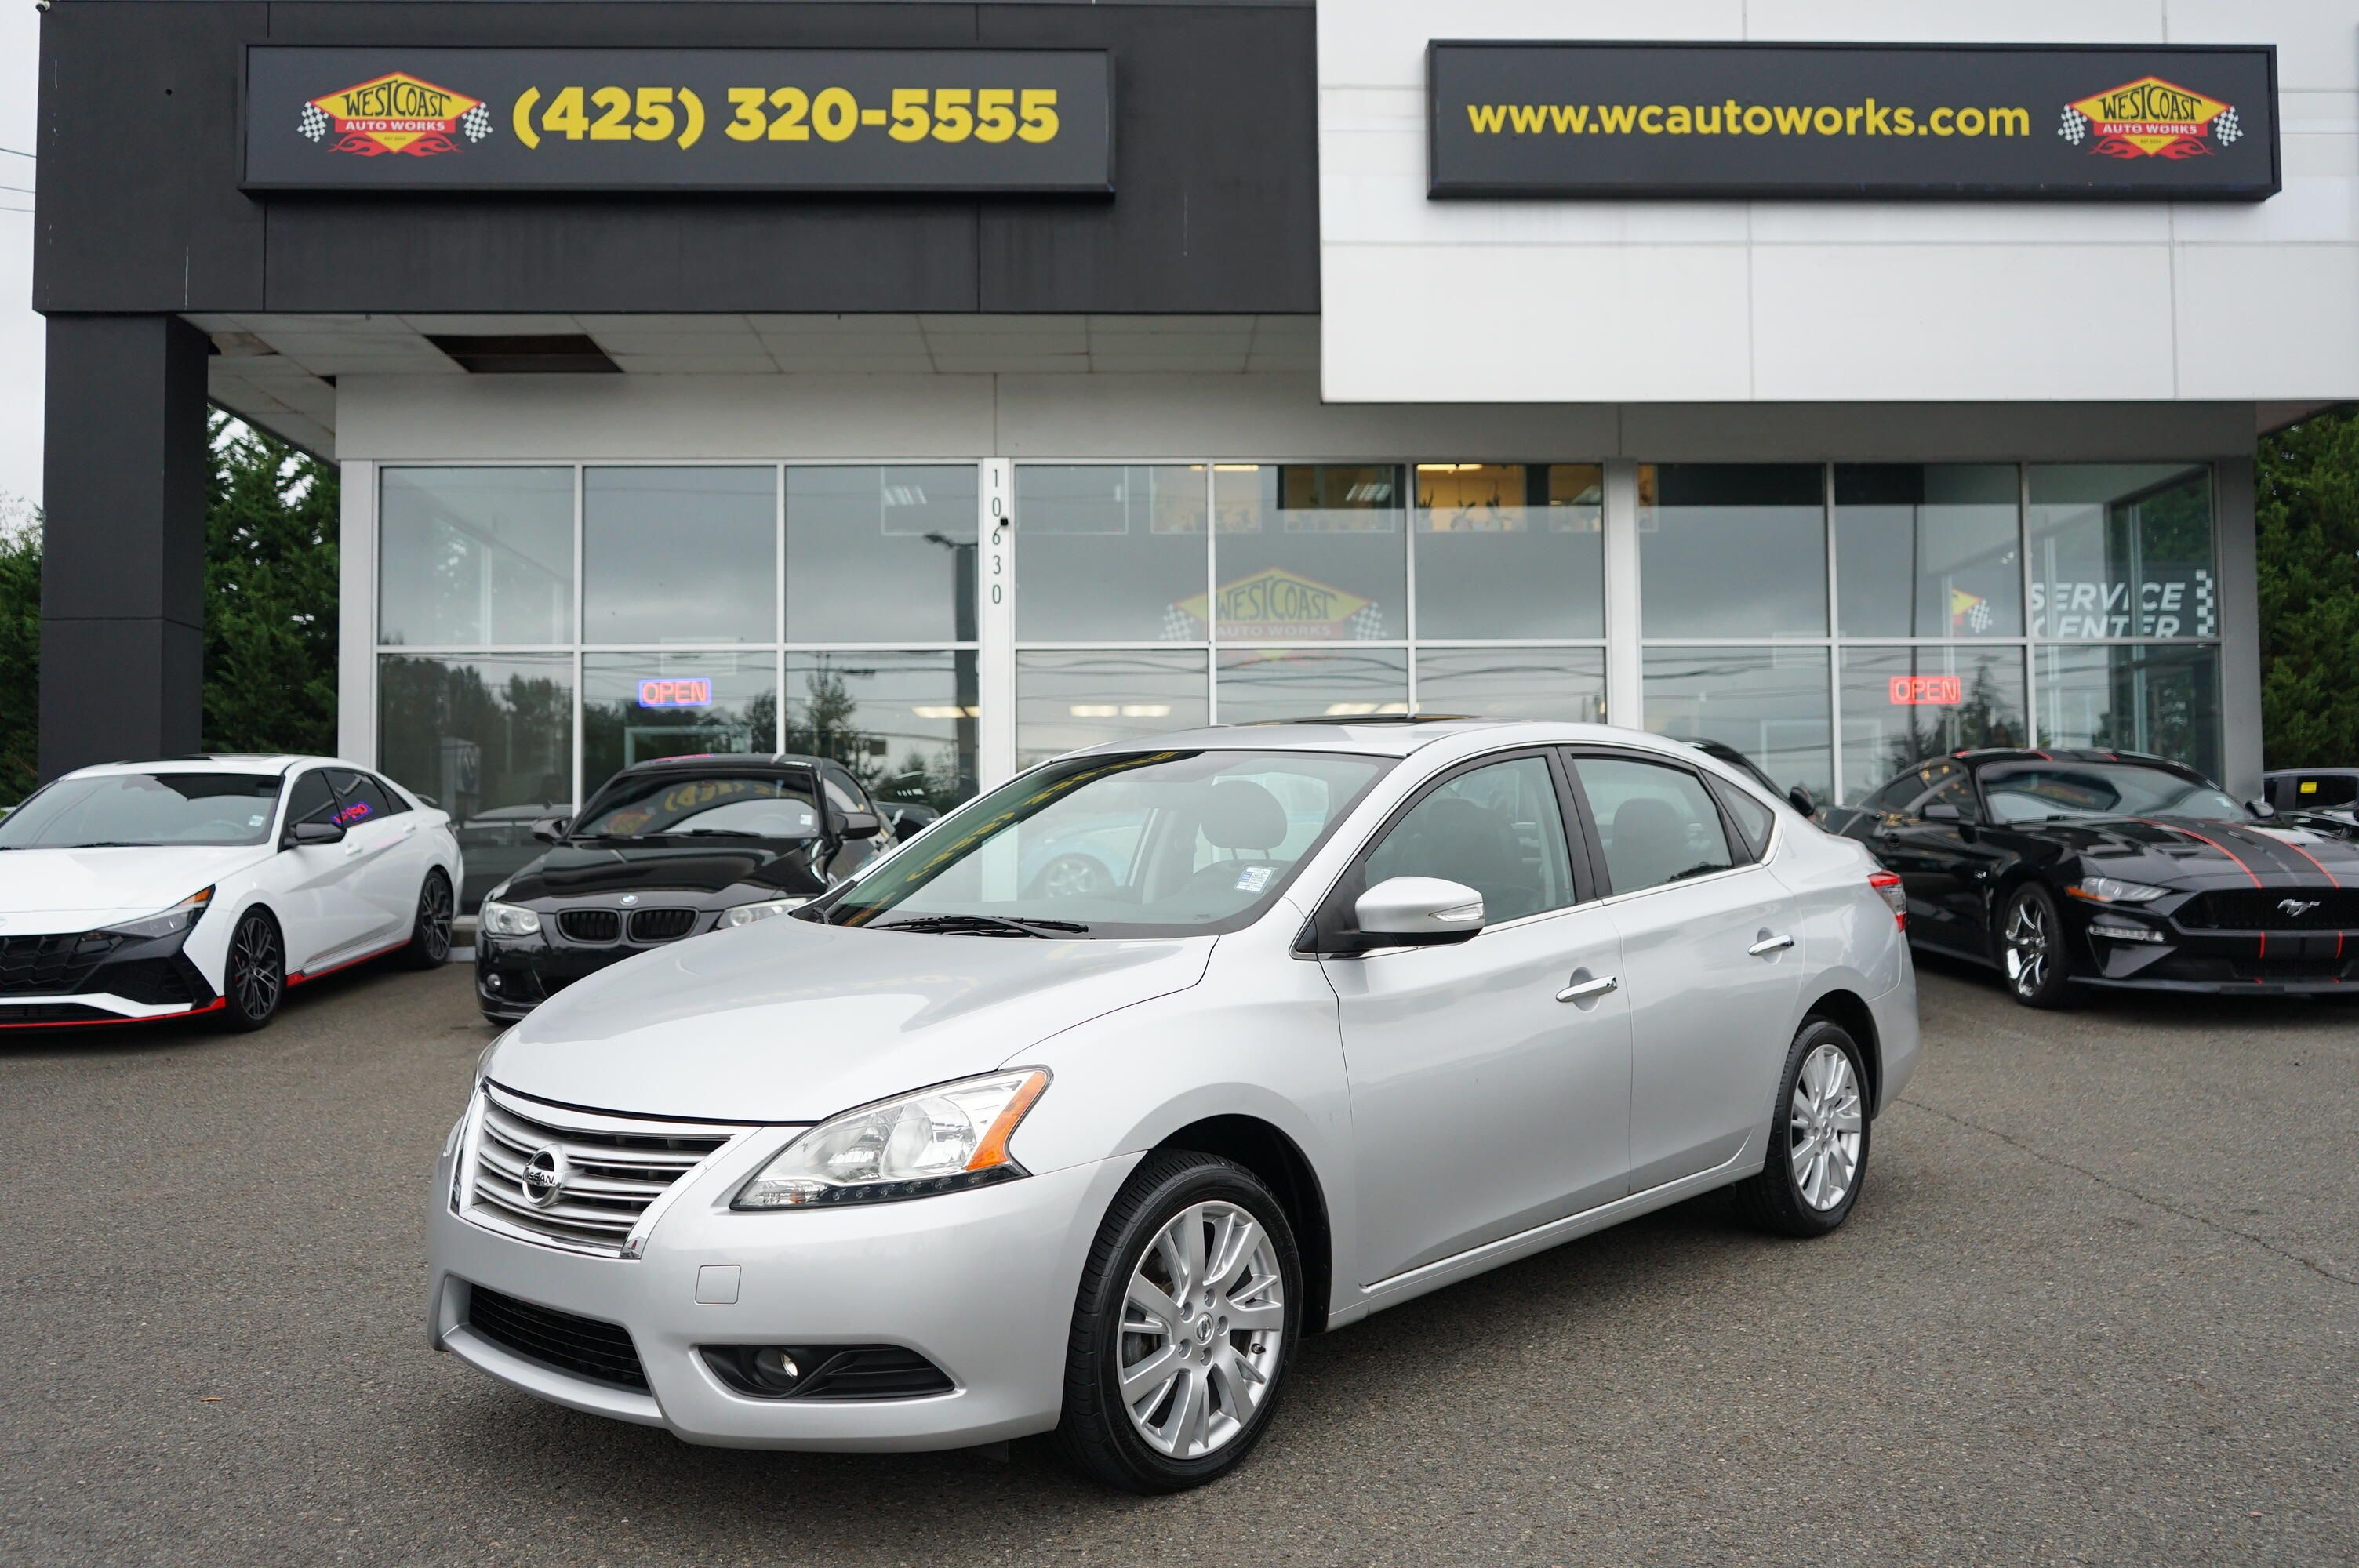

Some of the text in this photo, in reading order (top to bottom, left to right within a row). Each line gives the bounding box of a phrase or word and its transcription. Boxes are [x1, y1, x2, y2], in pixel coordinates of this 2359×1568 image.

[340, 79, 453, 118] WESTCOAST
[2096, 83, 2203, 122] WESTCOAST
[345, 120, 445, 132] AUTO WORKS
[512, 85, 1060, 151] (425) 320-5555
[1466, 97, 2031, 137] www.wcautoworks.com
[2103, 123, 2198, 135] AUTO WORKS
[1267, 624, 1332, 637] WORKS
[642, 681, 707, 705] OPEN
[1895, 679, 1957, 701] OPEN
[525, 1167, 556, 1185] SSAN
